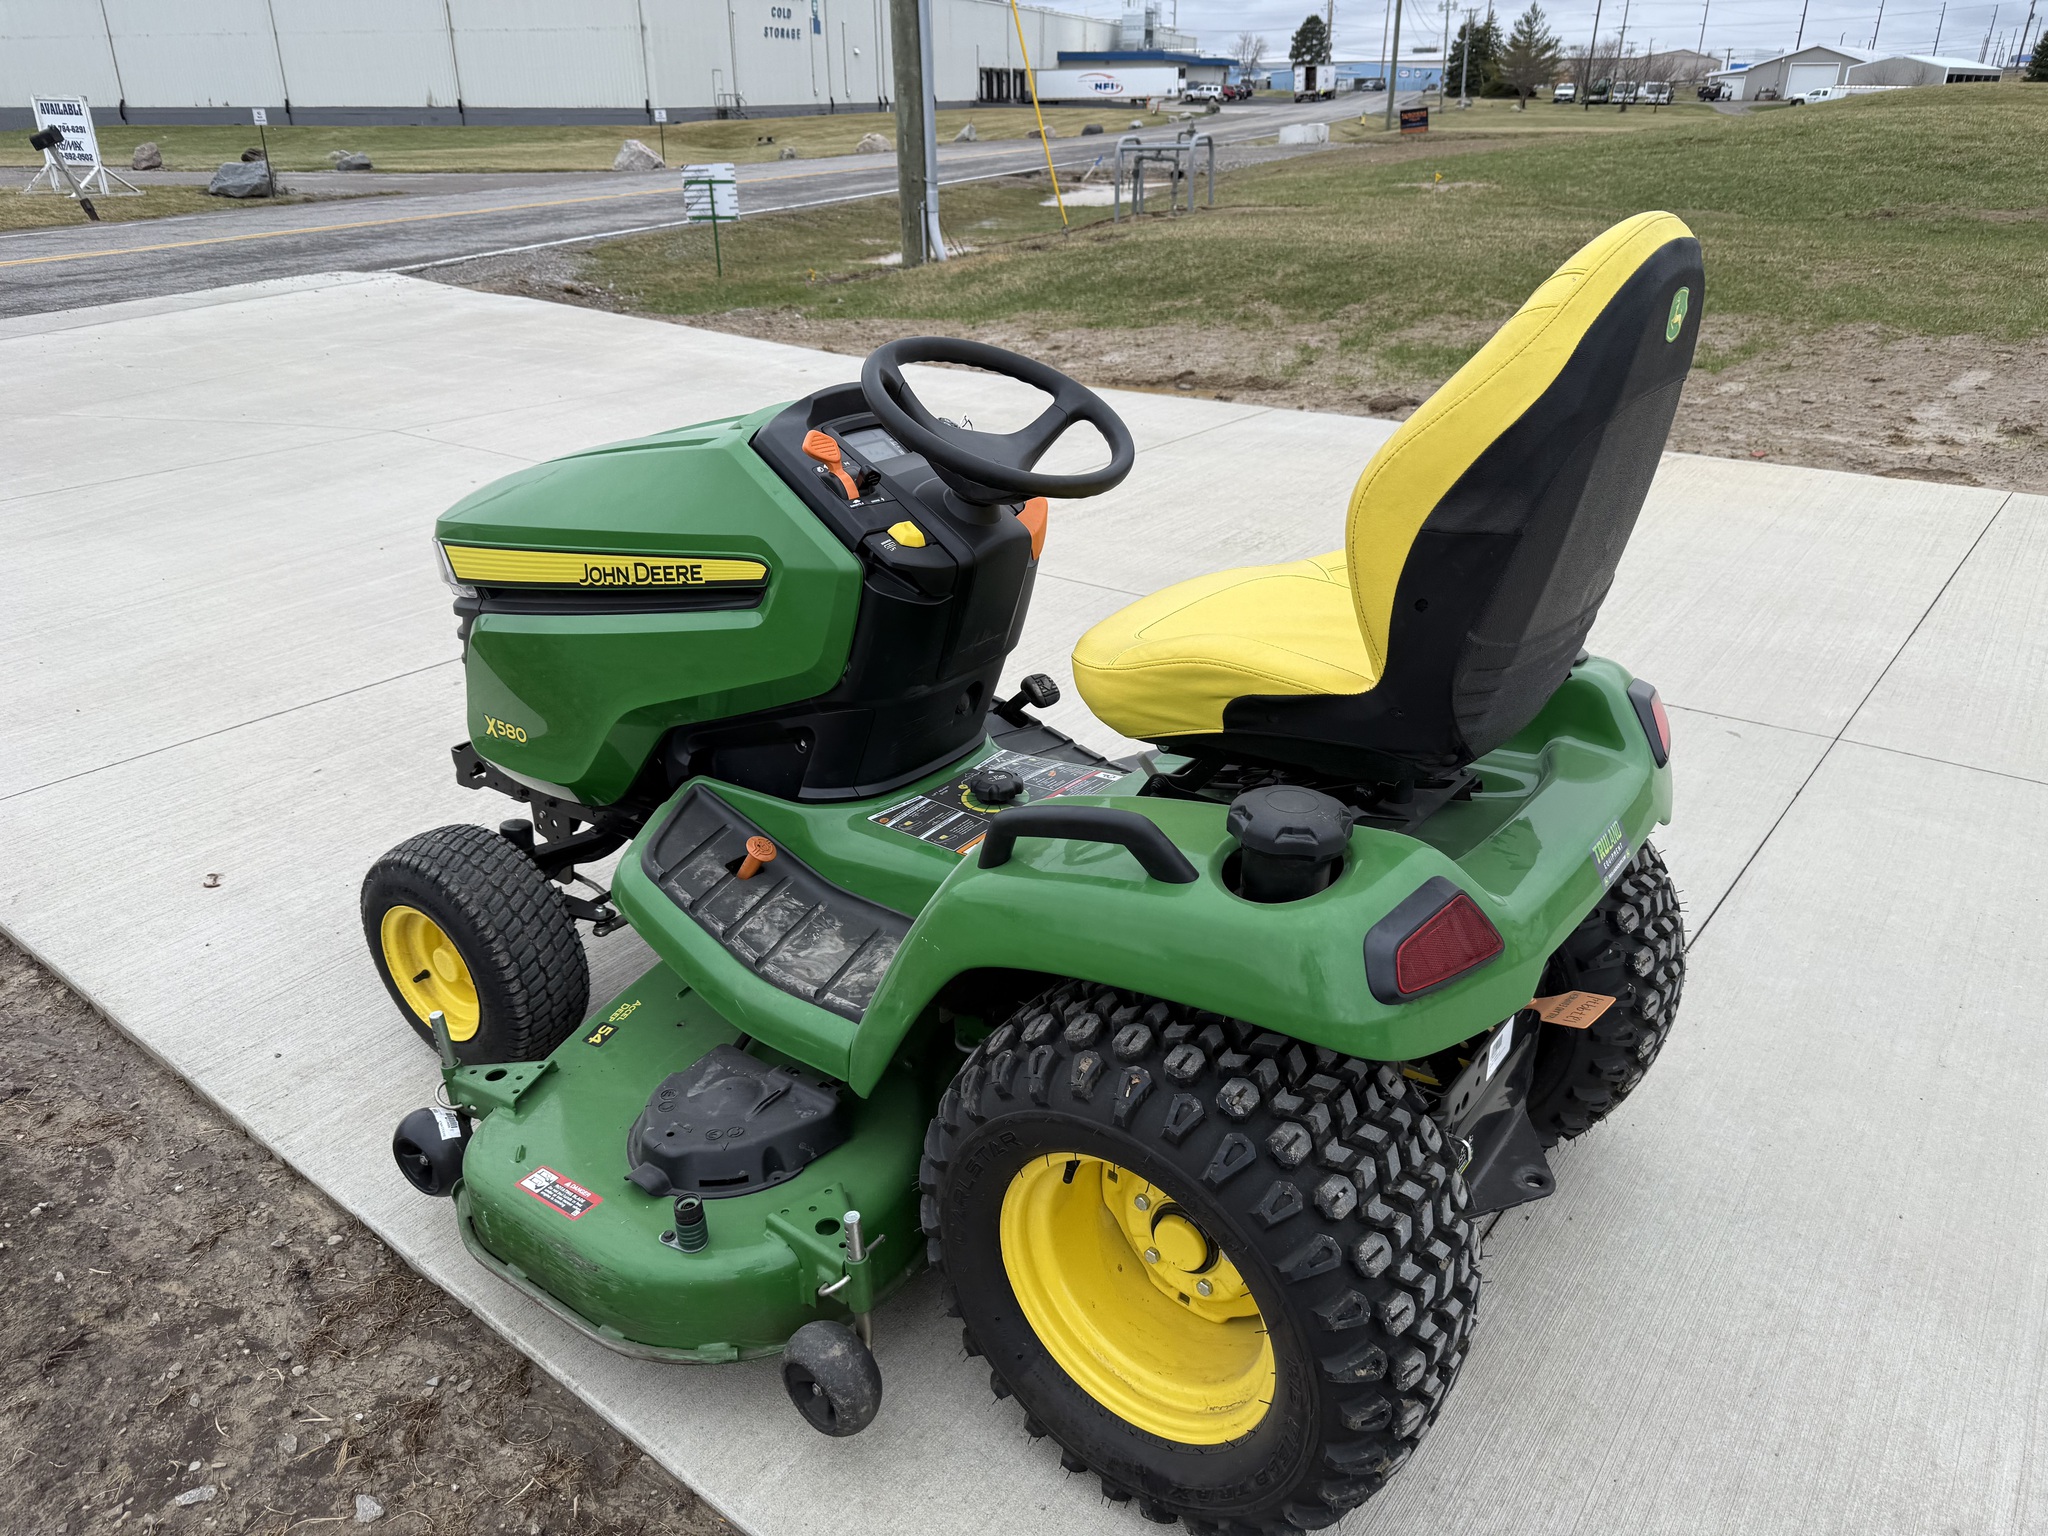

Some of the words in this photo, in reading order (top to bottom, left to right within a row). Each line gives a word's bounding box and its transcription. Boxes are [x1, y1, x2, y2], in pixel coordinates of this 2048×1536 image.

[771, 6, 792, 19] COLD
[763, 26, 801, 40] STORAGE
[1095, 82, 1114, 90] NFI
[39, 102, 83, 116] AVAILABLE
[579, 562, 631, 585] JOHN
[633, 562, 705, 584] DEERE
[484, 714, 527, 743] X580
[1591, 820, 1623, 865] TRULAND
[1603, 842, 1623, 870] EQUIPMENT
[608, 1002, 631, 1022] DEEP
[616, 999, 642, 1021] ACCEL
[588, 1024, 614, 1044] 54
[569, 1182, 592, 1198] DANGER
[572, 1193, 586, 1204] BLADE
[1168, 1475, 1251, 1502] TRAX
